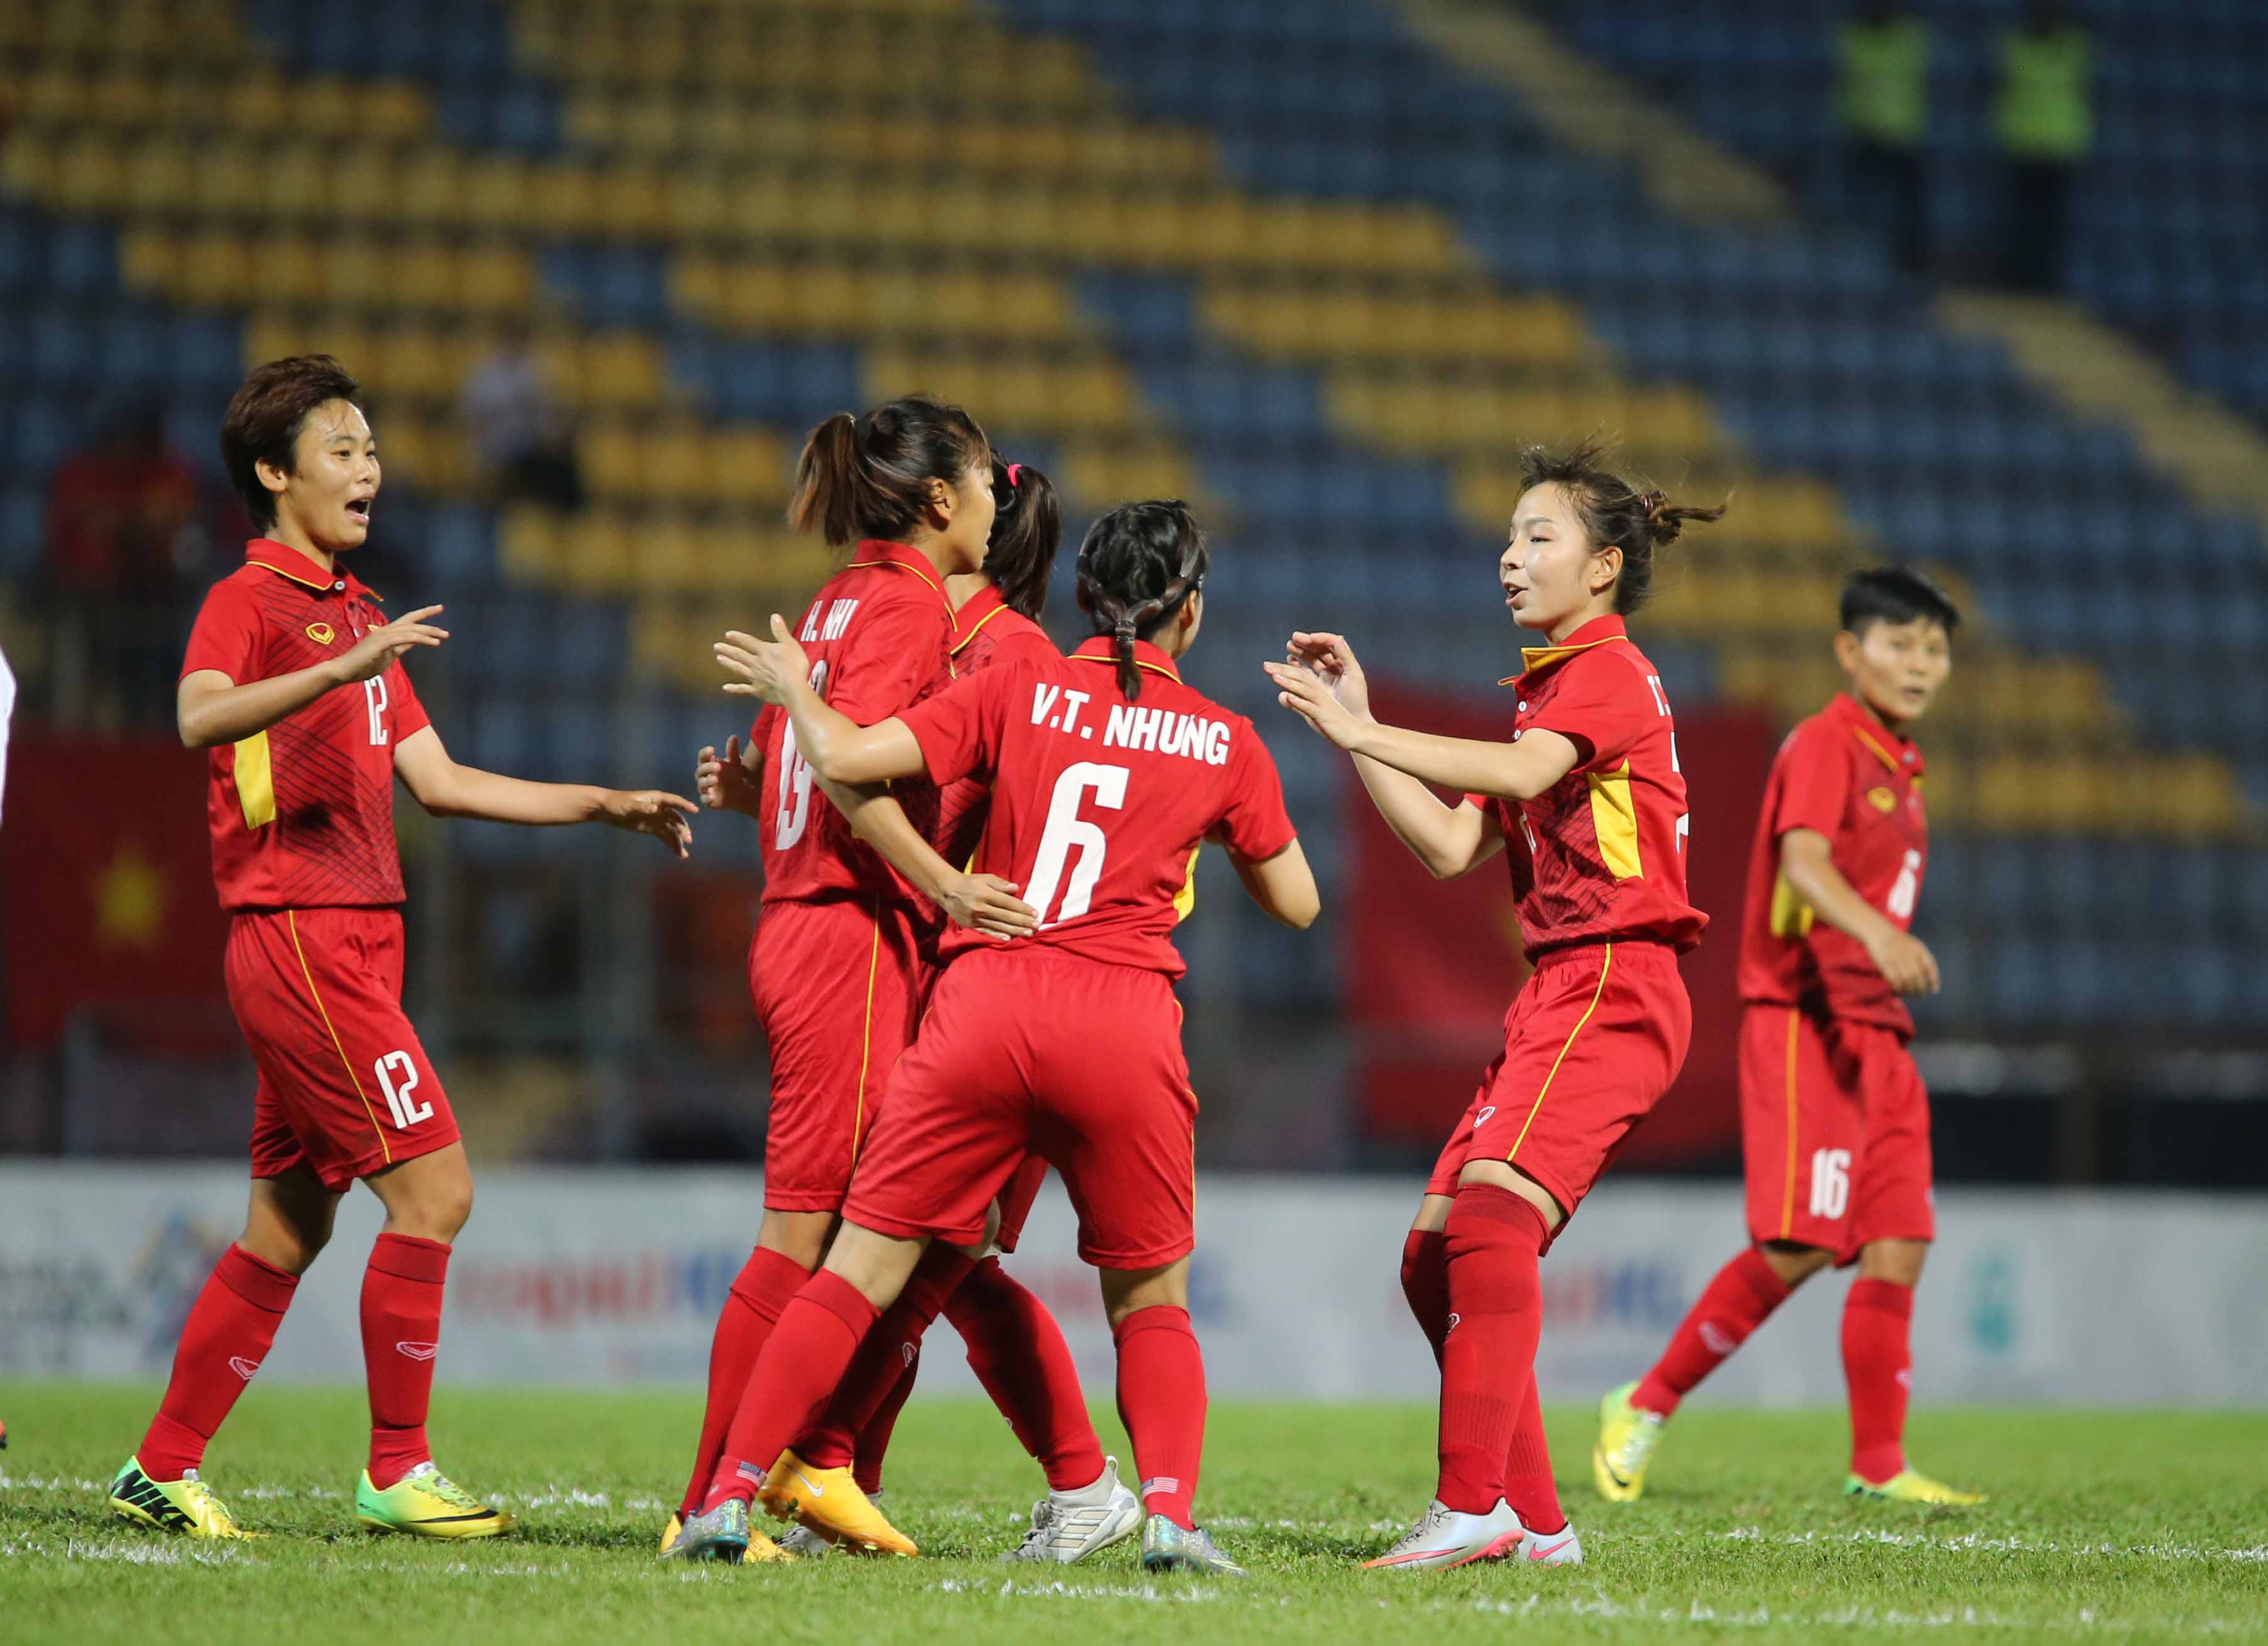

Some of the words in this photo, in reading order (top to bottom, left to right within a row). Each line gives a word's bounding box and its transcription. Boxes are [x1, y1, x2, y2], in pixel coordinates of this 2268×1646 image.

[363, 674, 388, 746] 12
[1030, 683, 1093, 740] V.T.
[1103, 704, 1231, 765] NHUNG
[1021, 761, 1131, 931] 6
[374, 1050, 435, 1129] 12
[1809, 1148, 1852, 1220] 16
